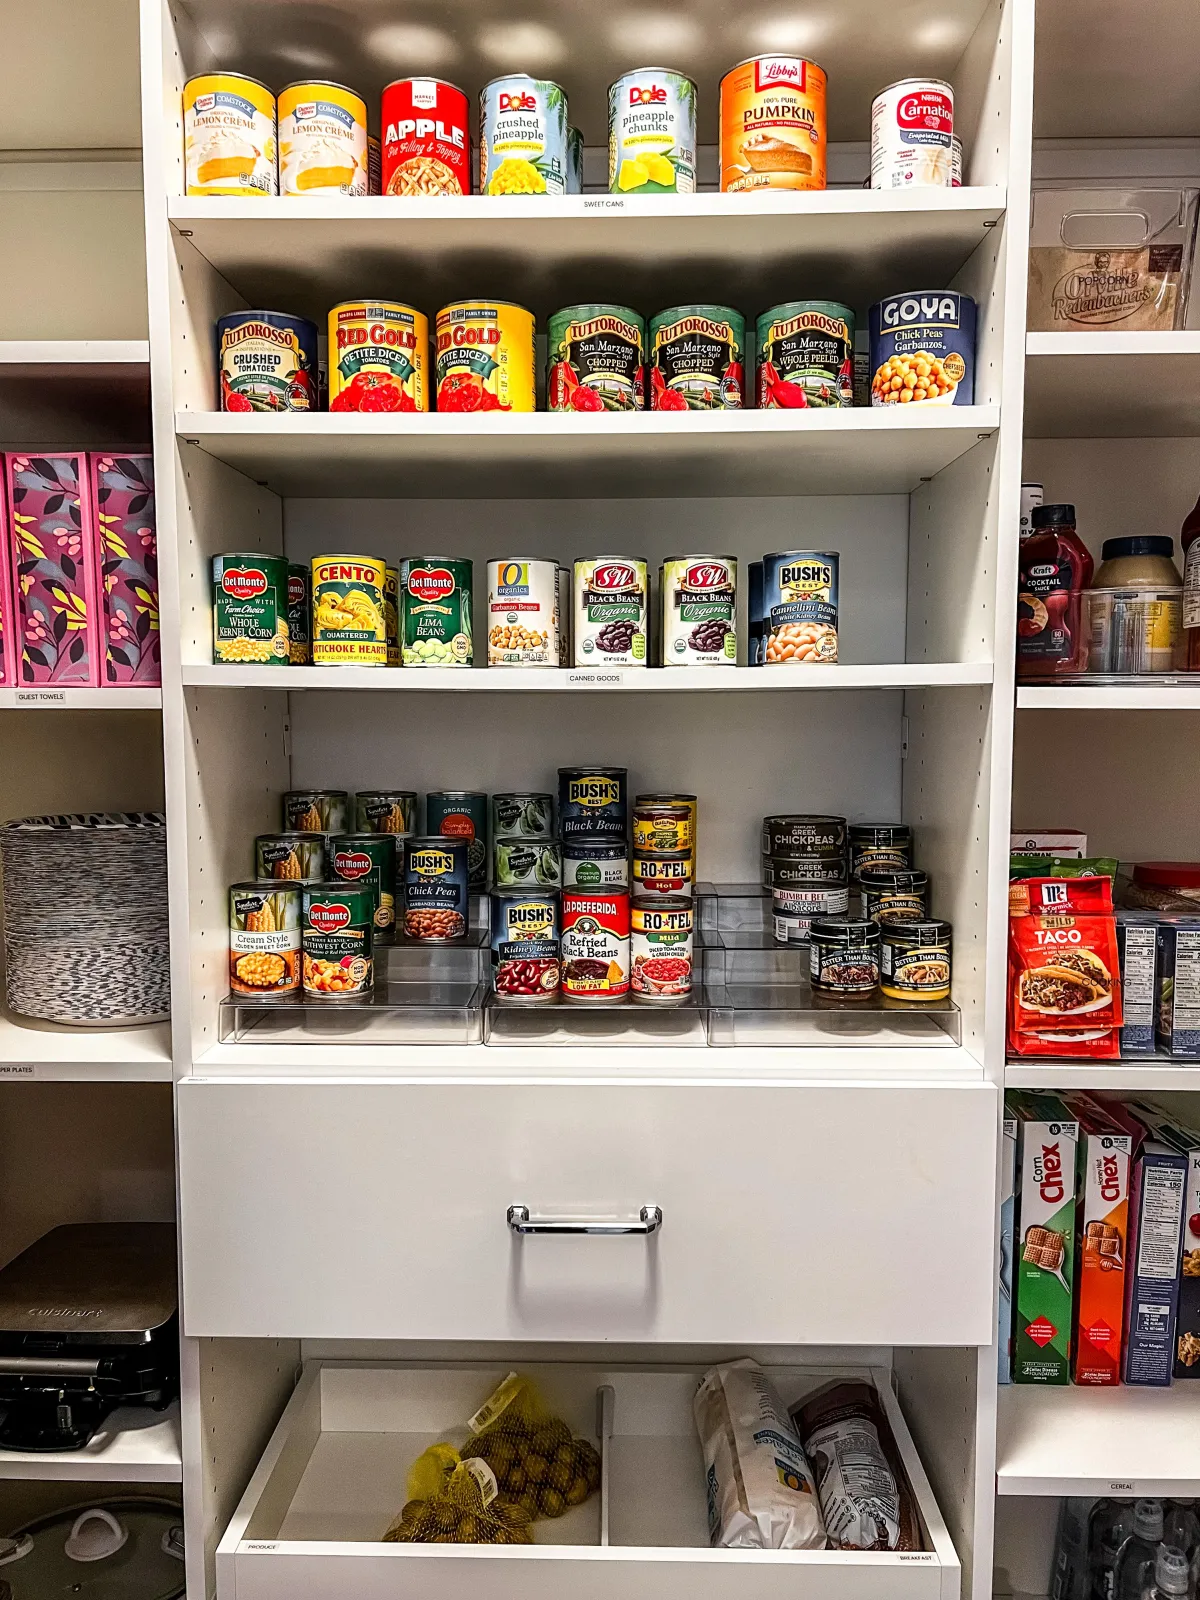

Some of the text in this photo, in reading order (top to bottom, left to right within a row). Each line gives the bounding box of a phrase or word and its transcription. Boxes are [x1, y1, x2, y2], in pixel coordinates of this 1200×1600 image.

[764, 63, 798, 79] Libby's
[500, 92, 536, 111] Dole
[630, 85, 666, 104] Dole
[217, 96, 252, 113] COMSTOCK
[900, 99, 952, 120] Carnation
[318, 105, 351, 123] COMSTOCK
[622, 111, 674, 127] pineapple
[744, 106, 815, 123] PUMPKIN
[194, 116, 220, 127] LEMON
[224, 115, 256, 130] CRÈME
[497, 117, 539, 129] crushed
[629, 121, 668, 134] chunks
[293, 124, 322, 134] LEMON
[325, 126, 354, 141] CRÈME
[385, 119, 464, 149] APPLE
[493, 130, 543, 143] pineapple
[388, 140, 462, 166] Pie Filling & Topping
[1079, 277, 1129, 285] POPCORN
[1053, 287, 1150, 320] Redenbacher's
[884, 298, 956, 326] GOYA
[571, 318, 638, 341] TUTTOROSSO
[660, 318, 728, 342] TUTTOROSSO
[774, 314, 843, 337] TUTTOROSSO
[226, 324, 292, 346] TUTTOROSSO
[336, 323, 416, 349] RED GOLD
[895, 329, 943, 341] Chick Peas
[580, 341, 633, 355] San Marzano
[666, 342, 721, 355] San Marzano
[781, 337, 838, 350] San Marzano
[895, 341, 942, 351] Garbanzos
[234, 354, 281, 365] CRUSHED
[344, 349, 407, 366] PETITE DICED
[587, 359, 627, 368] CHOPPED
[673, 359, 714, 368] CHOPPED
[780, 354, 838, 369] WHOLE PEELED
[320, 566, 374, 582] CENTO
[782, 567, 830, 584] BUSH'S
[225, 577, 264, 586] Del Monte
[411, 578, 451, 588] Del Monte
[499, 587, 527, 595] organics
[591, 605, 636, 620] Organic
[684, 605, 729, 620] Organic
[772, 603, 836, 616] Cannellini Beans
[229, 617, 259, 627] WHOLE
[419, 618, 442, 626] LIMA
[220, 627, 272, 637] KERNEL CORN
[417, 627, 445, 635] BEANS
[572, 782, 618, 799] BUSH'S
[566, 820, 622, 831] Black Beans
[775, 835, 833, 844] CHICKPEAS
[412, 855, 452, 869] BUSH'S
[780, 870, 838, 878] CHICKPEAS
[409, 886, 456, 896] Chick Peas
[780, 892, 808, 900] BUMBLE
[564, 901, 616, 915] LA PREFERIDA
[311, 911, 347, 920] Del Monte
[509, 908, 553, 924] BUSH'S
[238, 935, 265, 943] Cream
[570, 935, 606, 947] Refried
[1034, 930, 1081, 944] TACO
[504, 945, 533, 954] Kidney
[563, 945, 618, 958] Black Beans
[1082, 978, 1131, 986] COOKING
[1033, 1157, 1043, 1182] Corn
[1040, 1142, 1064, 1203] Chex
[1101, 1154, 1120, 1201] Chex
